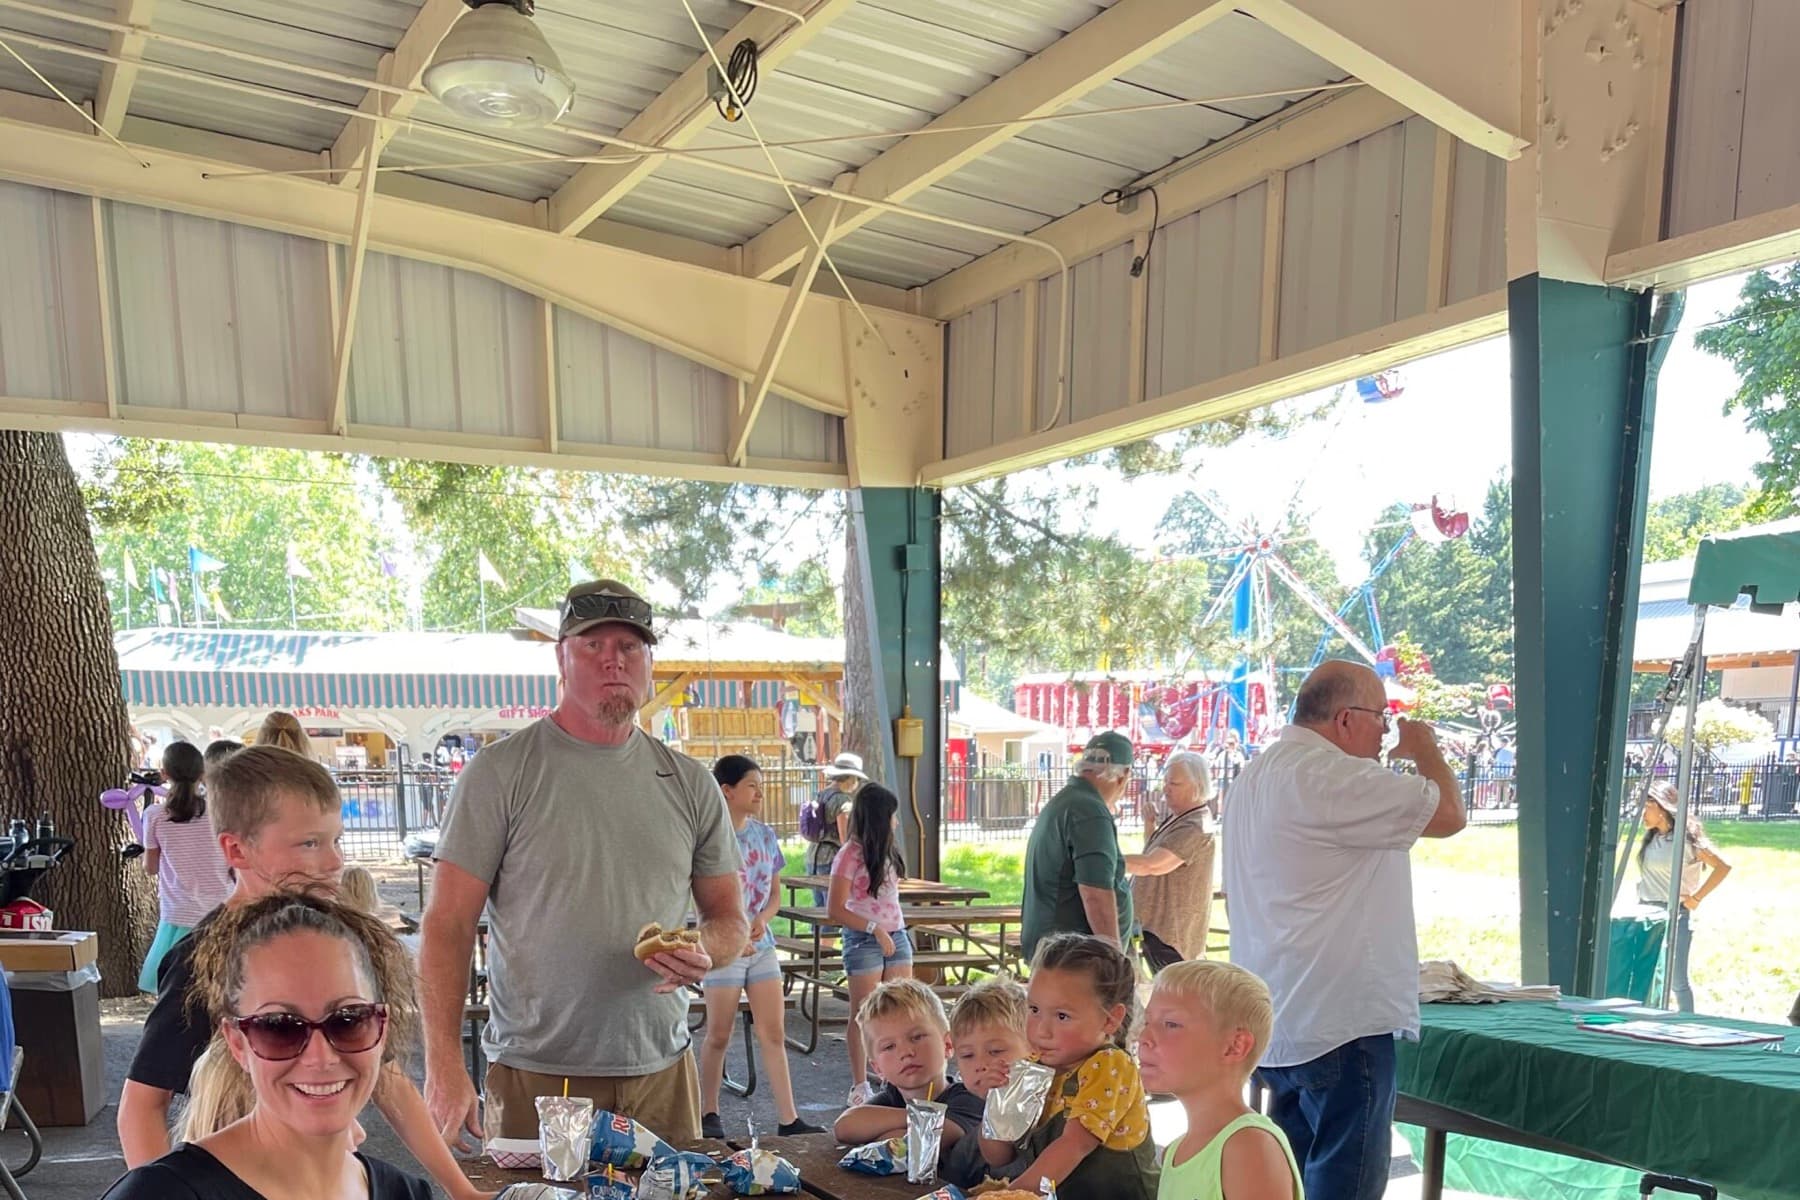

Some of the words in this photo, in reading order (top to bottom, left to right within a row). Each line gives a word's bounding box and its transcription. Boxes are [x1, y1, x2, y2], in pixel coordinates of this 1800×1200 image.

[292, 706, 312, 717] AKS
[314, 707, 340, 720] PARK
[499, 706, 524, 719] GIFT
